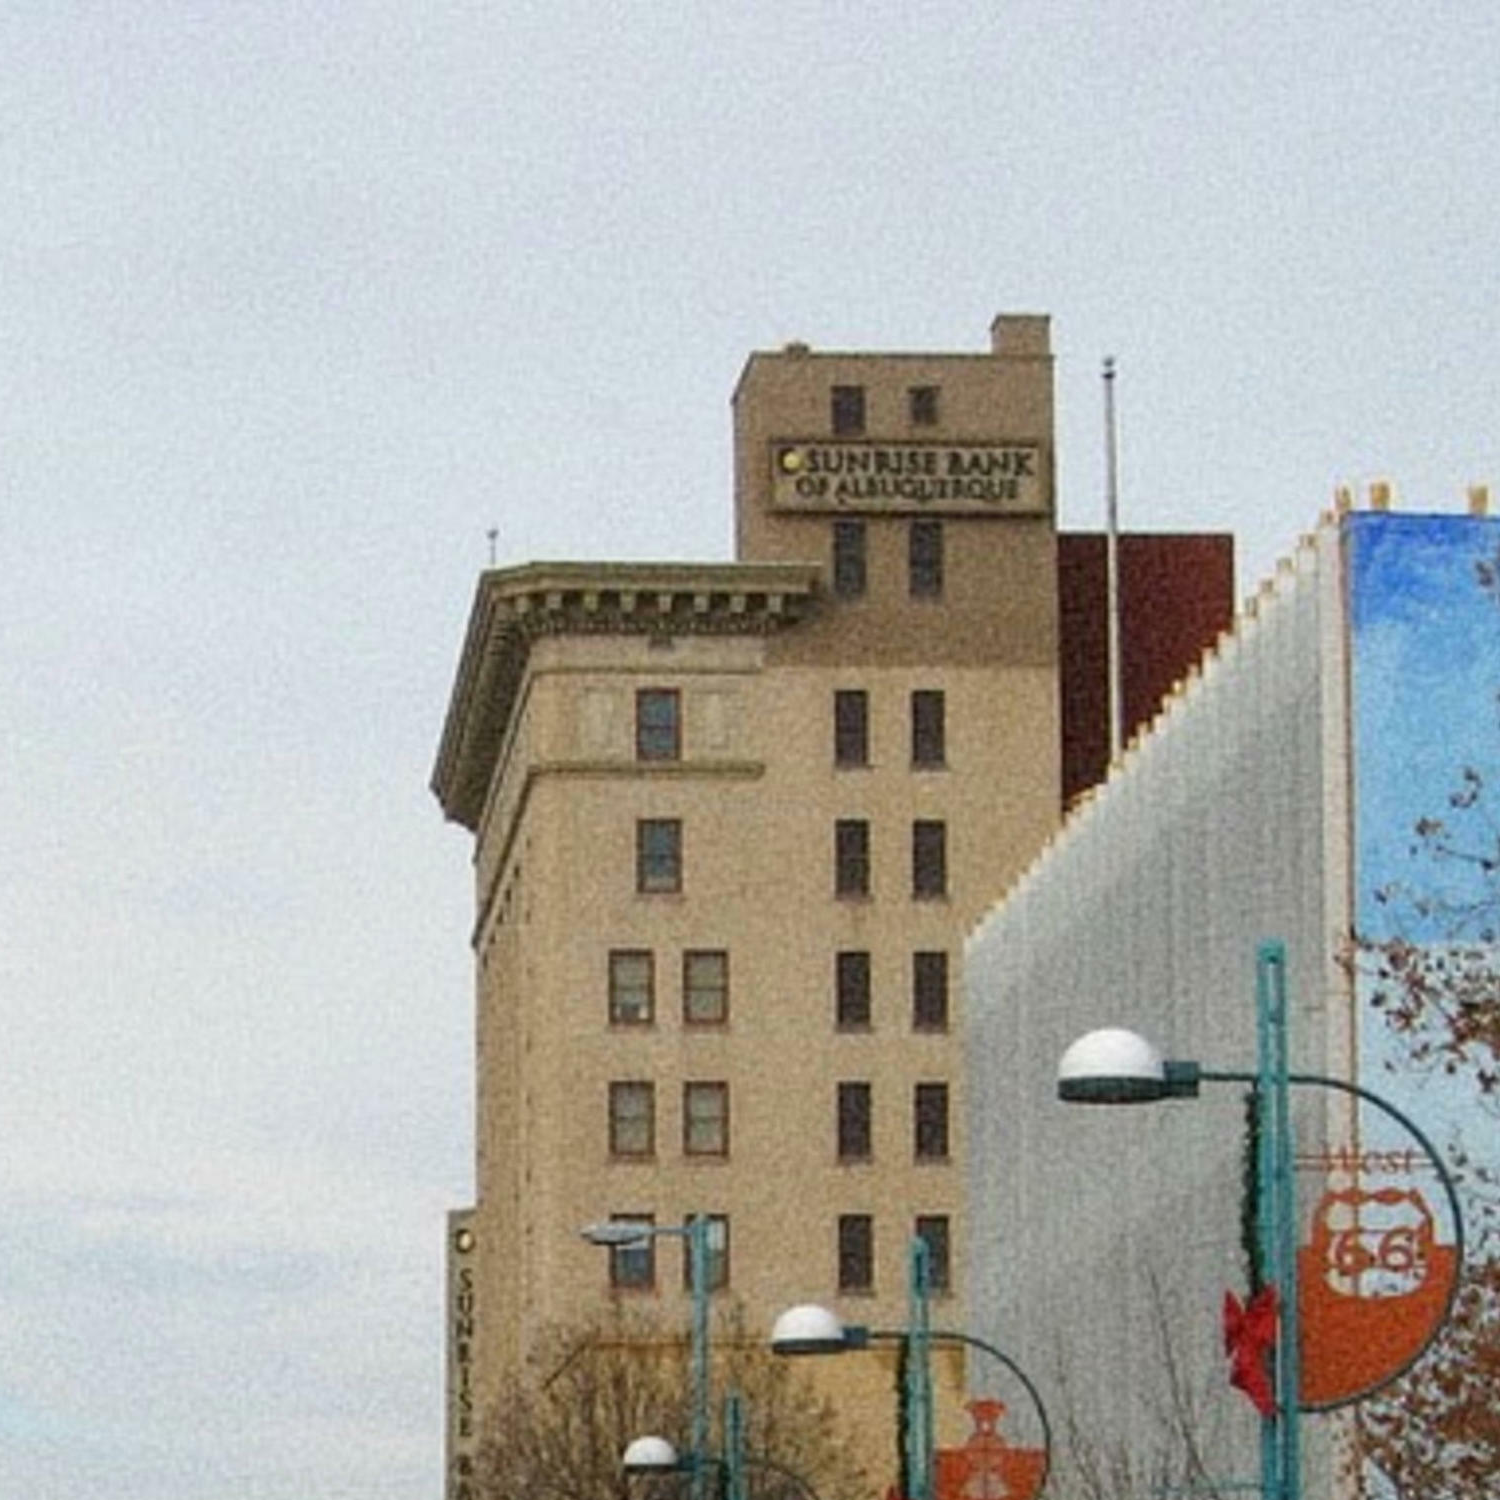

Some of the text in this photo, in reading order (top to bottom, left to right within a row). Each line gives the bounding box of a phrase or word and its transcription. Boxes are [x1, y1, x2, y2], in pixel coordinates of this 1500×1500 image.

[807, 449, 1035, 477] SUNRISE BANK
[795, 477, 1019, 503] OF ALBUQUERQUE
[1334, 1227, 1415, 1277] 66
[456, 1267, 474, 1438] SUNRISE
